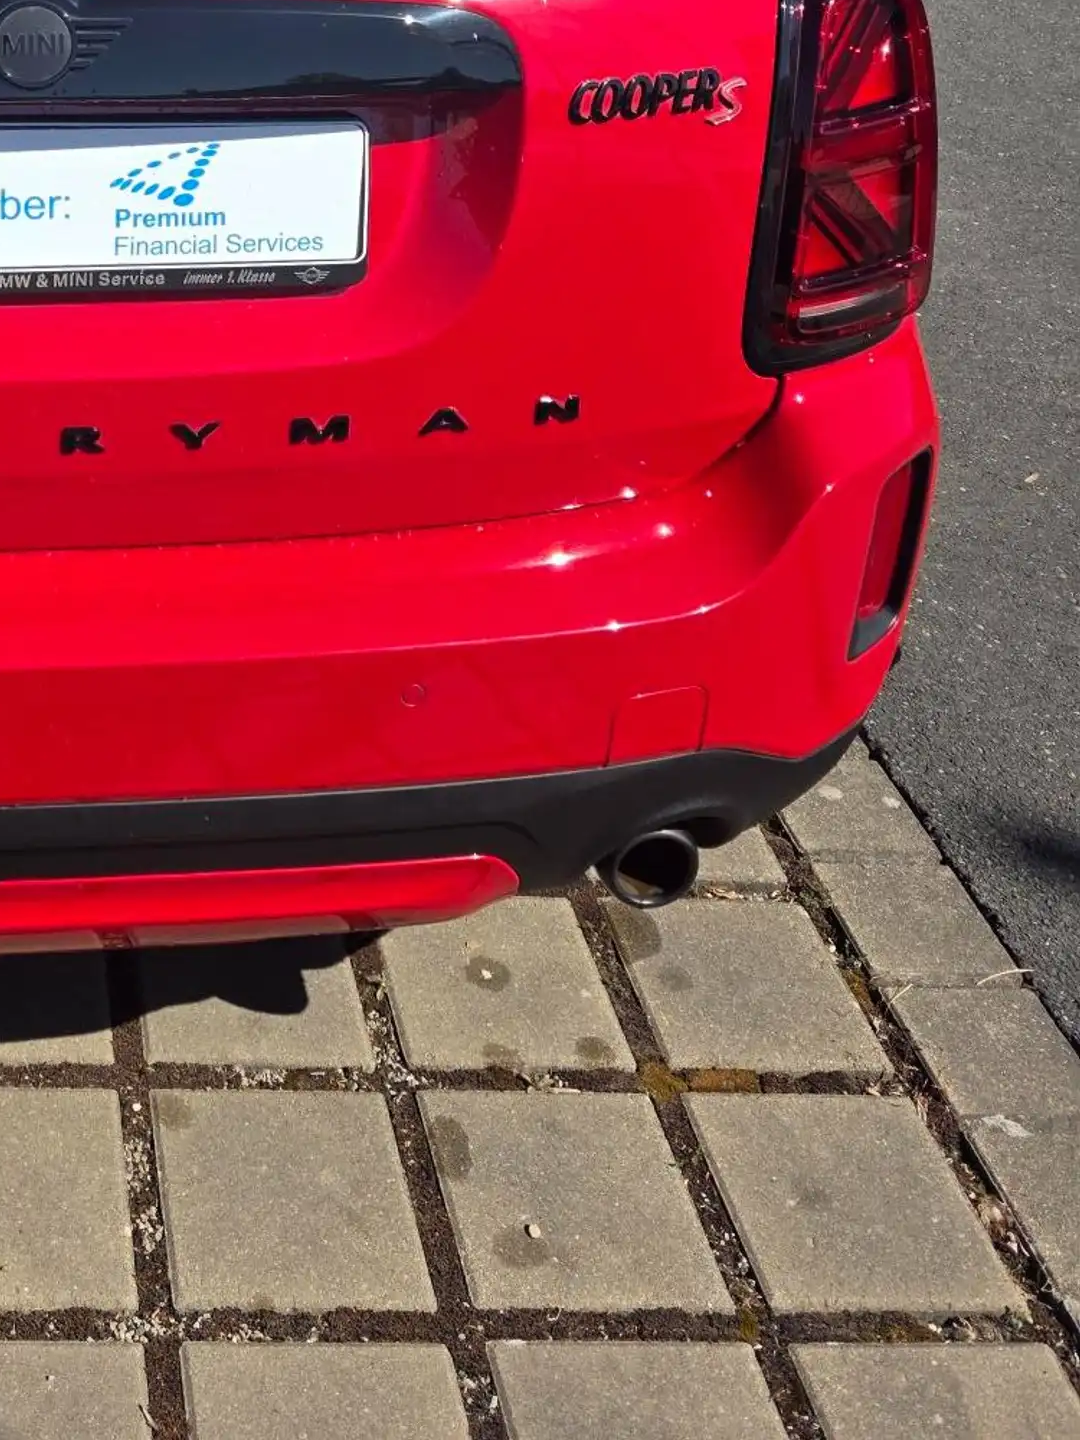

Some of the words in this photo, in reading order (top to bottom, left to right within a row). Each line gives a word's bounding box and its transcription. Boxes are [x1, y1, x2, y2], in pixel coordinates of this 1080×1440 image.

[2, 31, 66, 57] MINI
[568, 65, 720, 126] COOPER
[704, 76, 748, 126] S
[114, 208, 227, 228] Premium
[113, 234, 218, 256] Financial
[226, 232, 324, 254] Services
[35, 273, 48, 288] &
[52, 272, 94, 288] MINI
[98, 269, 166, 288] Service
[237, 268, 277, 285] Klasse
